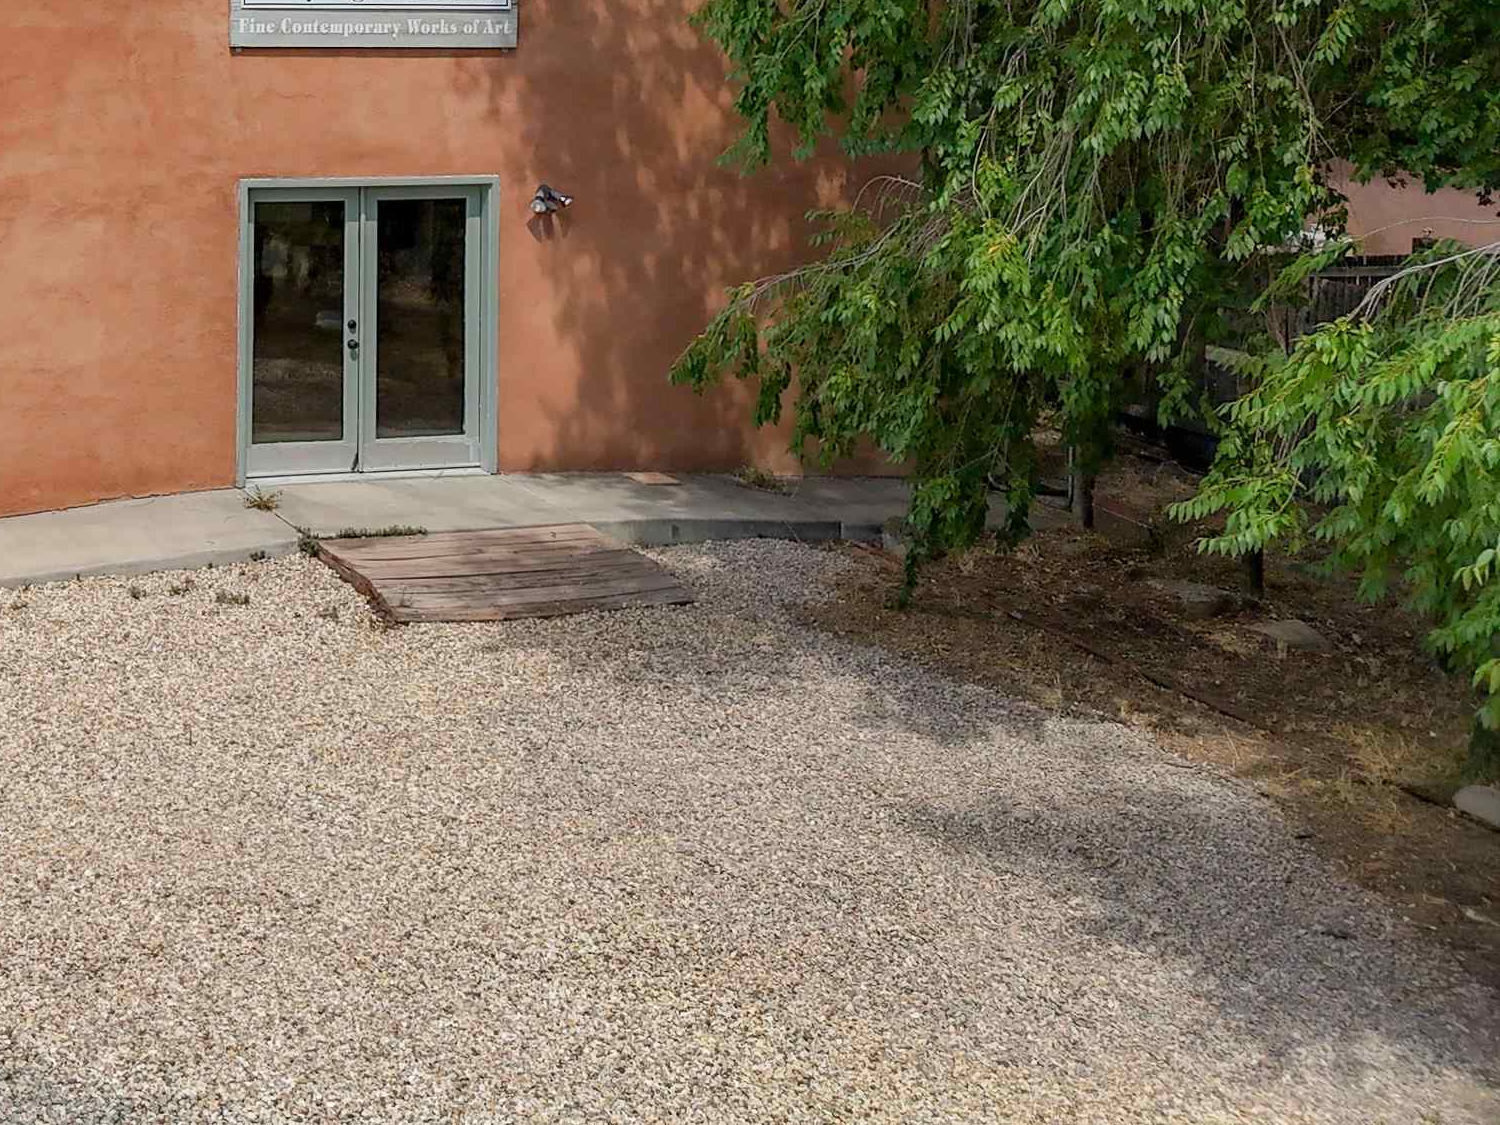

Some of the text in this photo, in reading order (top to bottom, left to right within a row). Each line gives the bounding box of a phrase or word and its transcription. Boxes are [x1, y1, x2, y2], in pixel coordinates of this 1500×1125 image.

[239, 18, 512, 37] Fine Contemporary Works of Art
